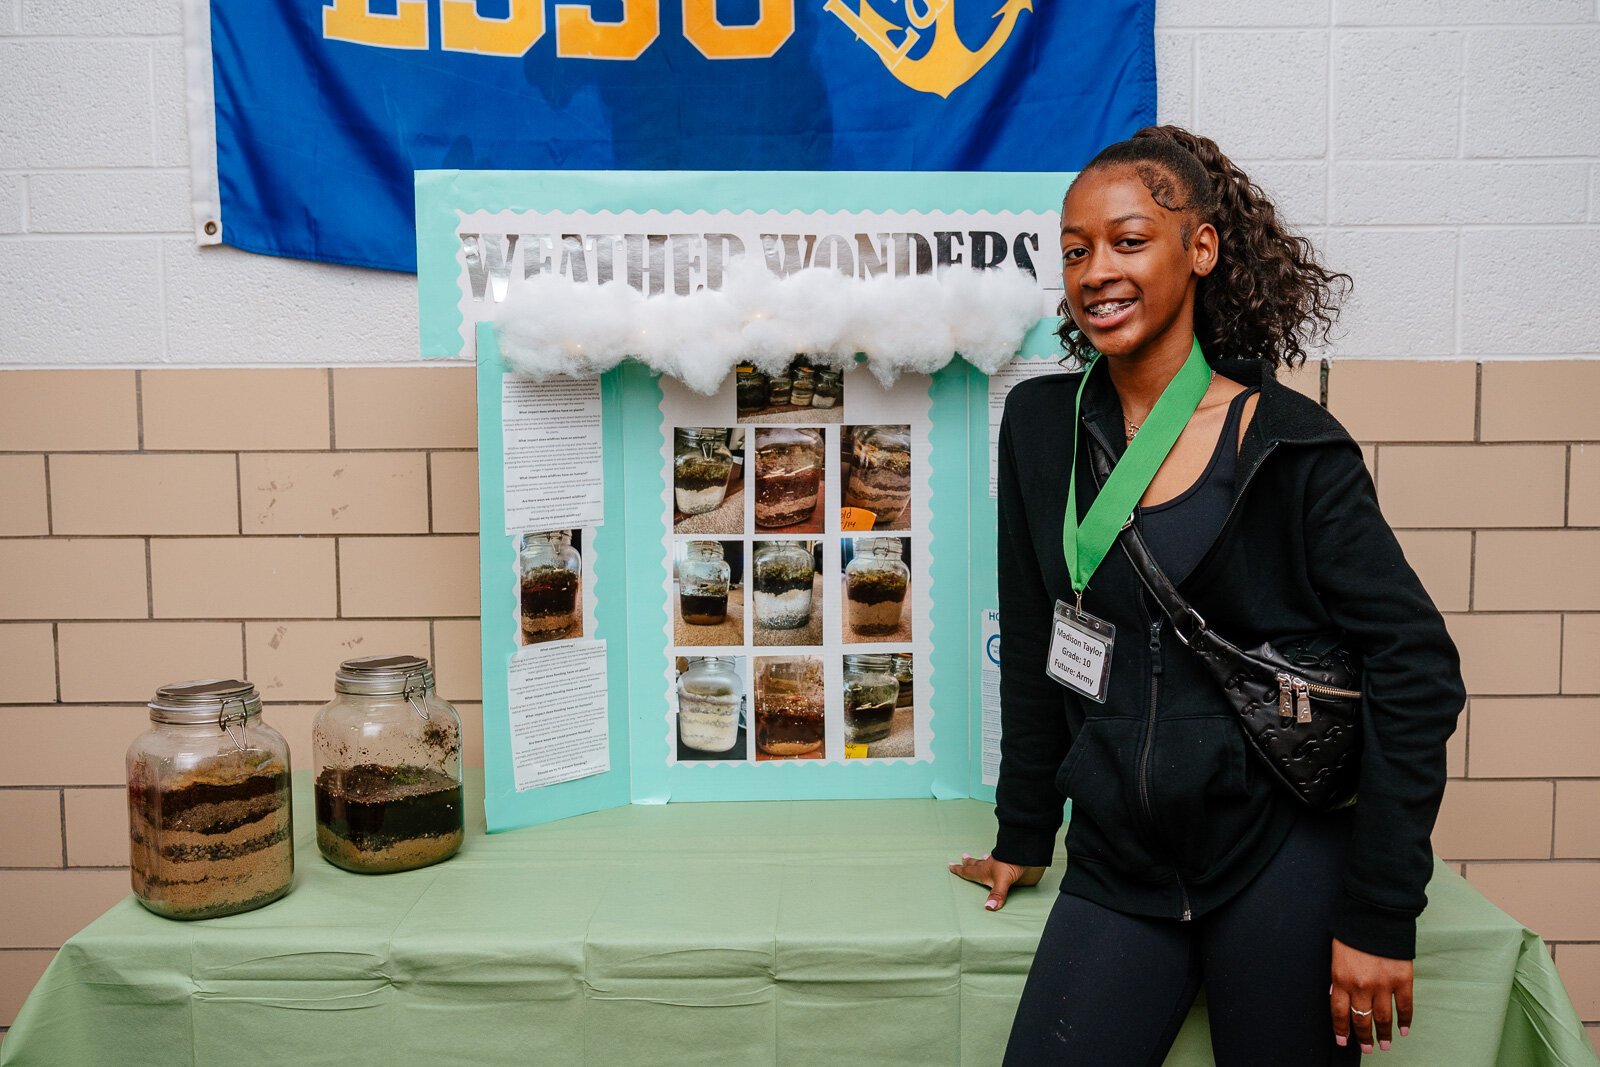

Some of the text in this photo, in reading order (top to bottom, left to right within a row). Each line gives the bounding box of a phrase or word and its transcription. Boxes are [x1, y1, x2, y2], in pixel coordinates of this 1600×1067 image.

[1057, 628, 1102, 657] Madison Taylor
[1062, 647, 1091, 668] Grade: 10
[1054, 658, 1094, 686] Future: Army
